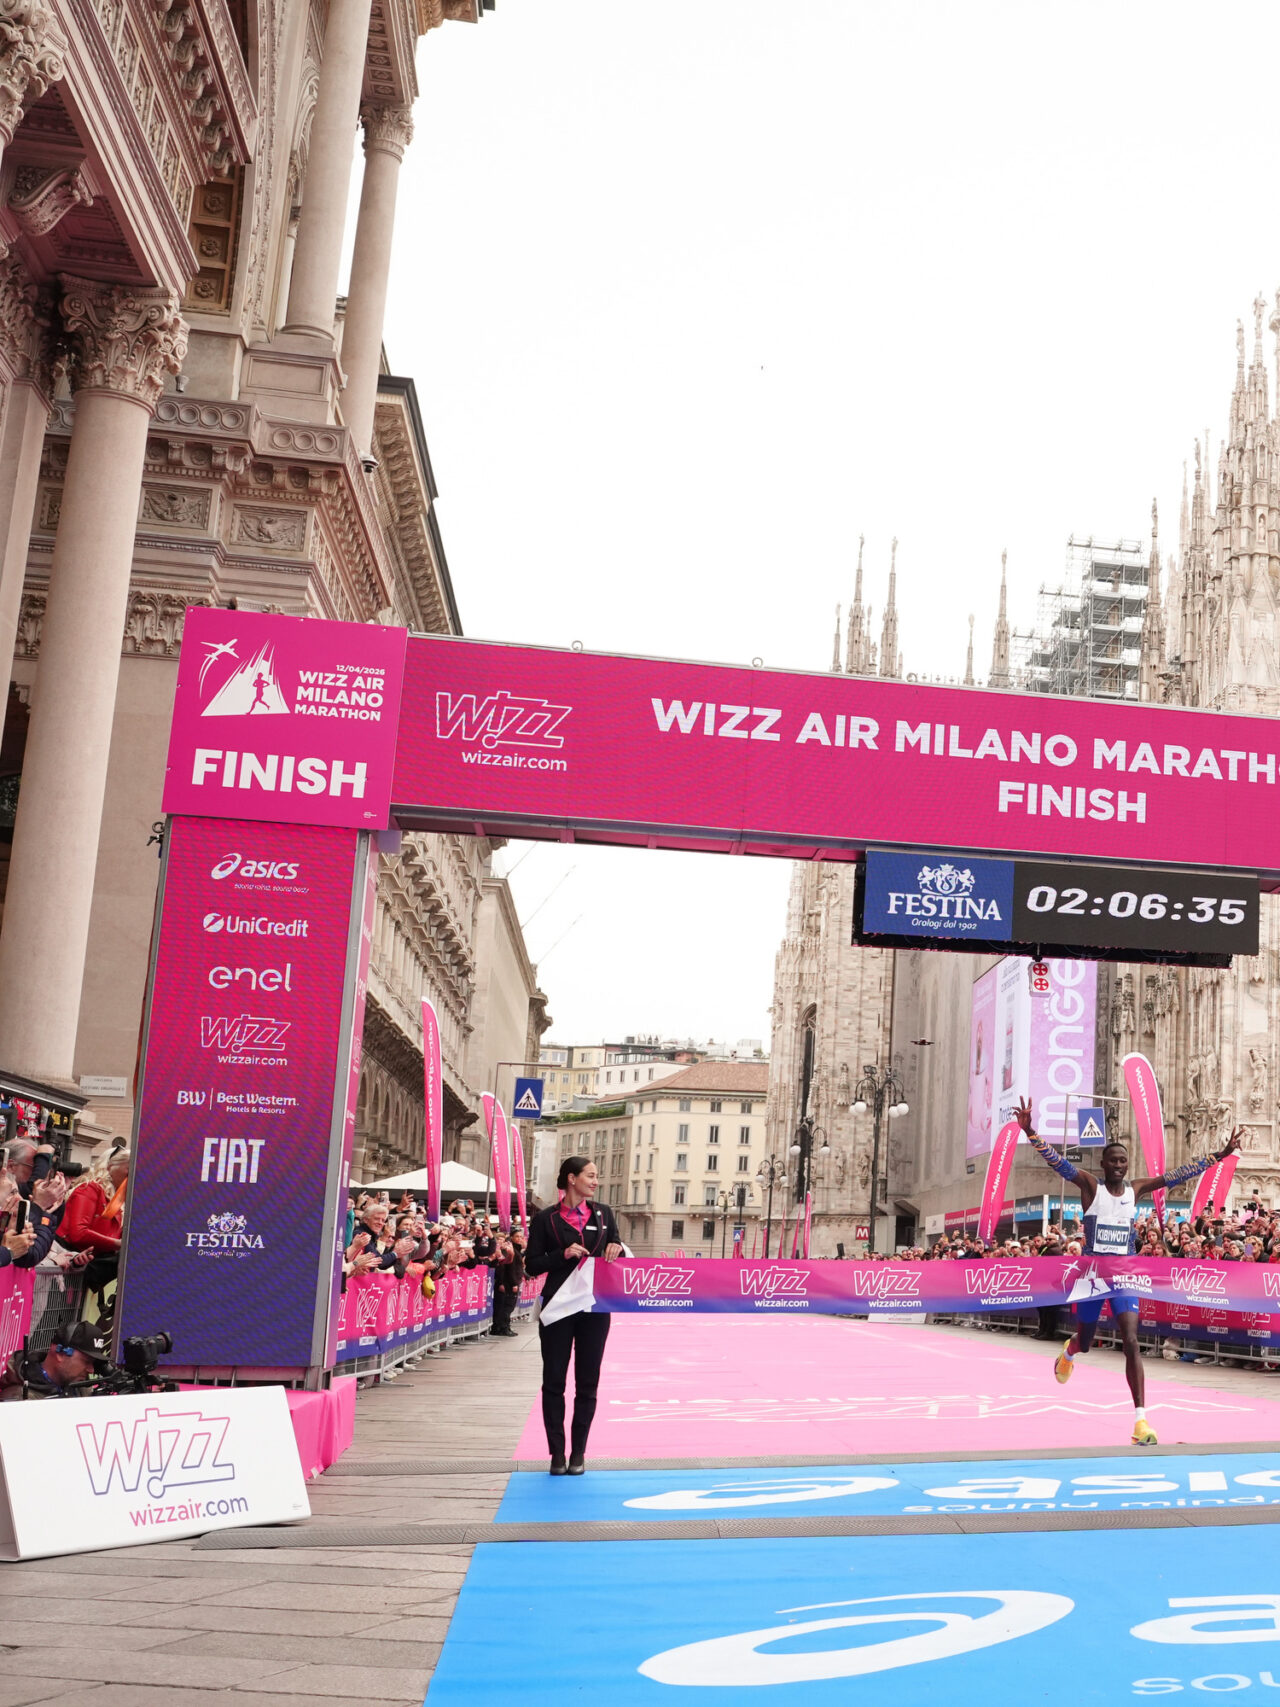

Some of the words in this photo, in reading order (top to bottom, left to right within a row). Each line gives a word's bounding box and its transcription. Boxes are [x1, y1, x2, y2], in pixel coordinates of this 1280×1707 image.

[336, 664, 385, 676] 12/04/2026
[298, 671, 347, 687] WIZZ
[352, 676, 384, 691] AIR
[297, 686, 384, 707] MILANO
[295, 705, 381, 722] MARATHON
[652, 698, 782, 741] WIZZ
[796, 712, 879, 750] AIR
[895, 720, 1077, 767] MILANO
[461, 751, 567, 771] wizzair.com
[191, 749, 367, 799] FINISH
[998, 781, 1146, 823] FINISH
[240, 860, 299, 879] asics
[887, 892, 1002, 921] FESTINA
[1027, 886, 1247, 924] 02:06:35
[227, 916, 308, 937] UniCredit
[209, 963, 292, 992] enel
[218, 1054, 288, 1065] wizzair.com
[177, 1091, 205, 1105] BW
[217, 1093, 244, 1103] Best
[201, 1138, 265, 1183] FIAT
[185, 1232, 265, 1248] FESTINA
[857, 1228, 869, 1238] M
[1097, 1229, 1128, 1242] KIBIWOTT
[1112, 1275, 1152, 1286] MILANO
[638, 1299, 693, 1307] wizzair.com
[755, 1299, 809, 1307] wizzair.com
[869, 1299, 922, 1308] wizzair.com
[981, 1295, 1033, 1305] wizzair.com
[1186, 1295, 1229, 1304] wizzair.com
[1119, 1494, 1280, 1508] mind,
[130, 1496, 248, 1527] wizzair.com
